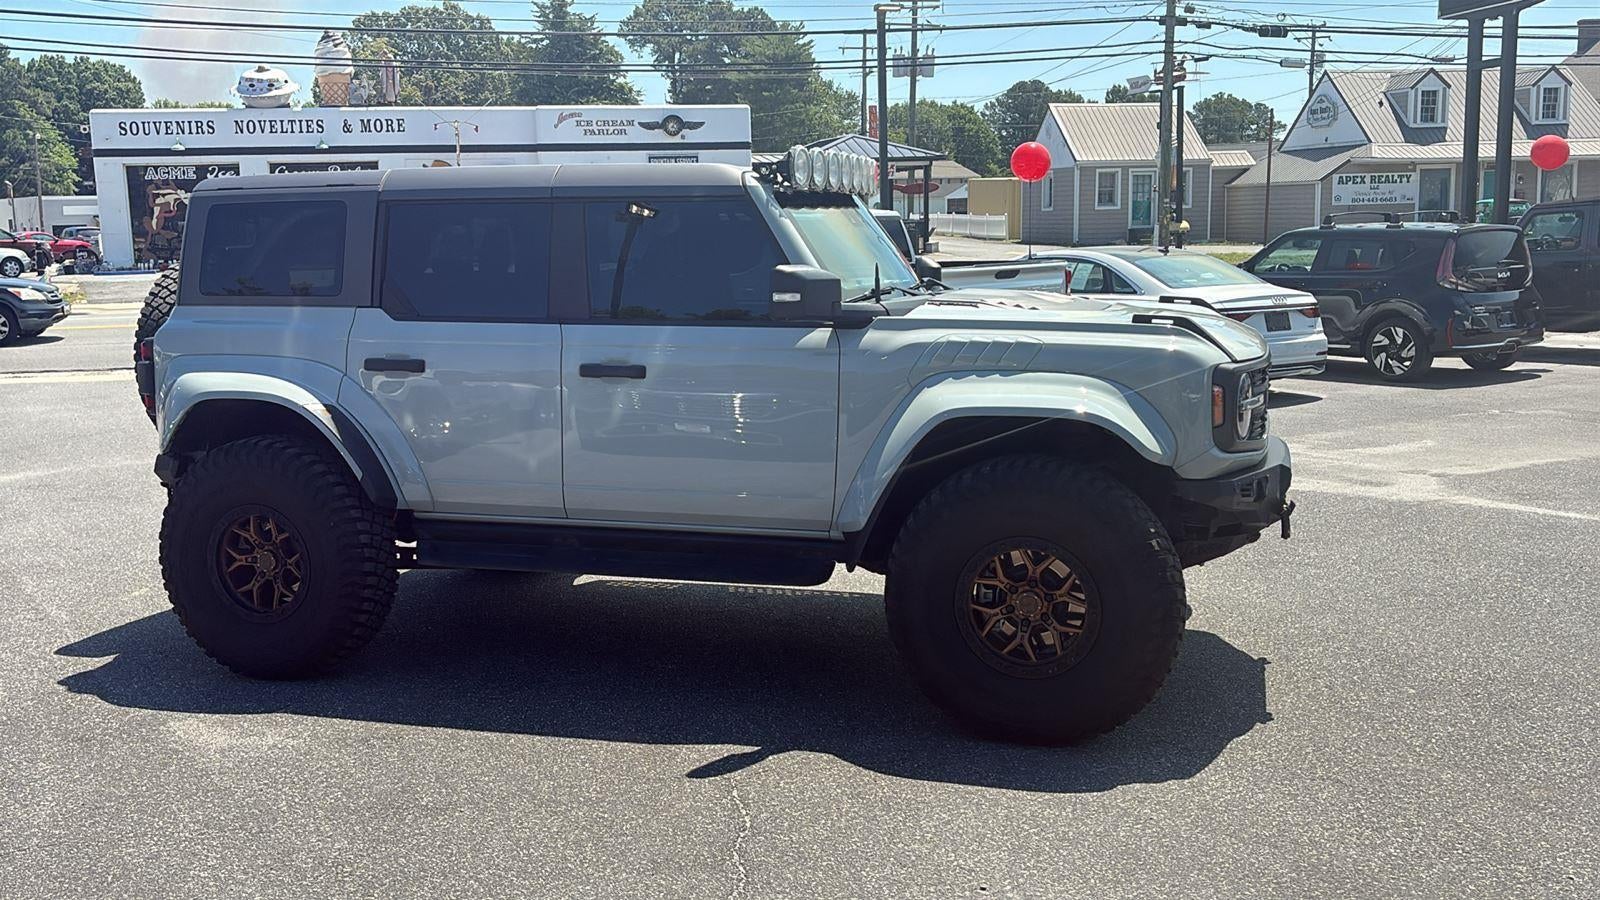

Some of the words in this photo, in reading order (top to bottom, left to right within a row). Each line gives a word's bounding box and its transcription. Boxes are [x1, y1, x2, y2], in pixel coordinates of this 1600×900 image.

[118, 120, 216, 136] SOUVENIRS
[234, 119, 325, 135] NOVELTIES
[342, 118, 353, 134] &
[360, 118, 406, 133] MORE
[575, 119, 593, 127] ICE
[595, 119, 635, 127] CREAM
[583, 128, 628, 136] PARLOR
[144, 166, 197, 180] ACME
[1337, 175, 1367, 185] APEX
[1369, 174, 1412, 185] REALTY
